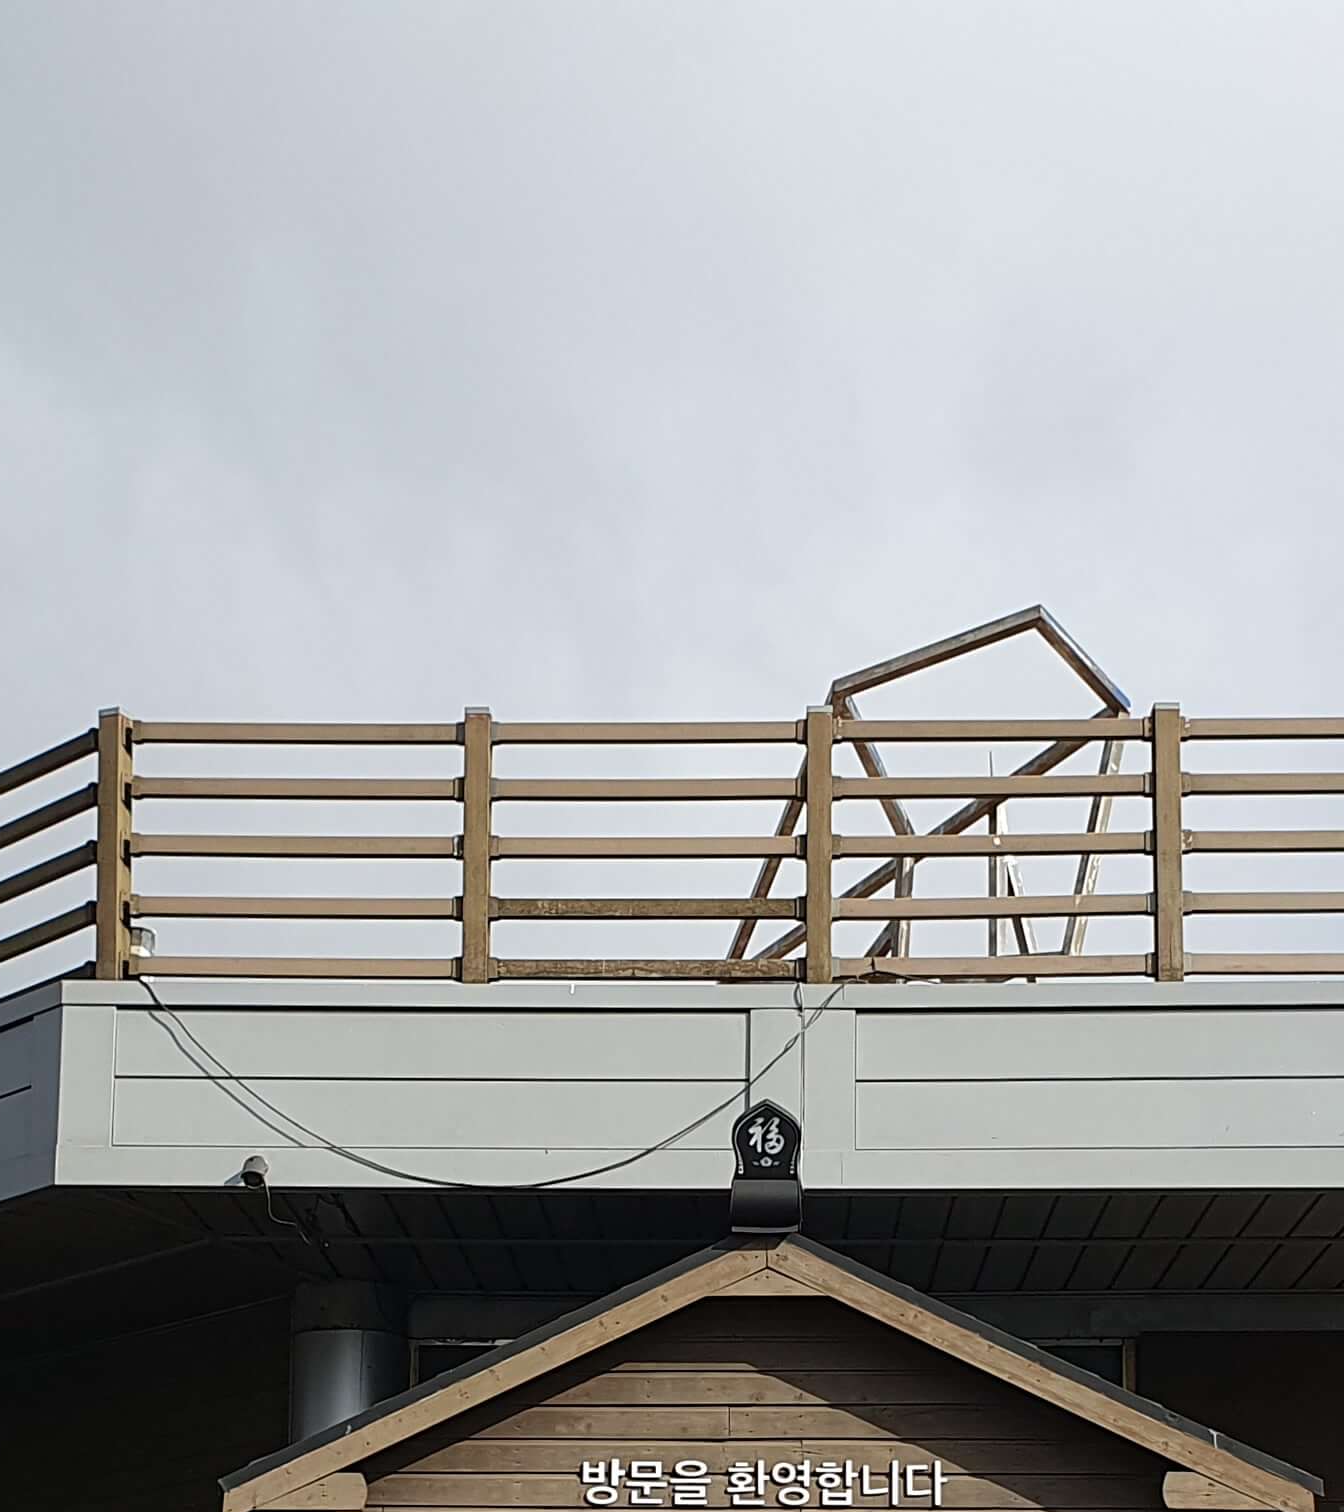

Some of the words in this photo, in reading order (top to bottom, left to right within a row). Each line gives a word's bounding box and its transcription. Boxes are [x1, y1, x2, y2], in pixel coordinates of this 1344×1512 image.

[747, 1116, 785, 1155] 福
[581, 1458, 712, 1506] 방문을
[726, 1458, 948, 1507] 환영합니다
